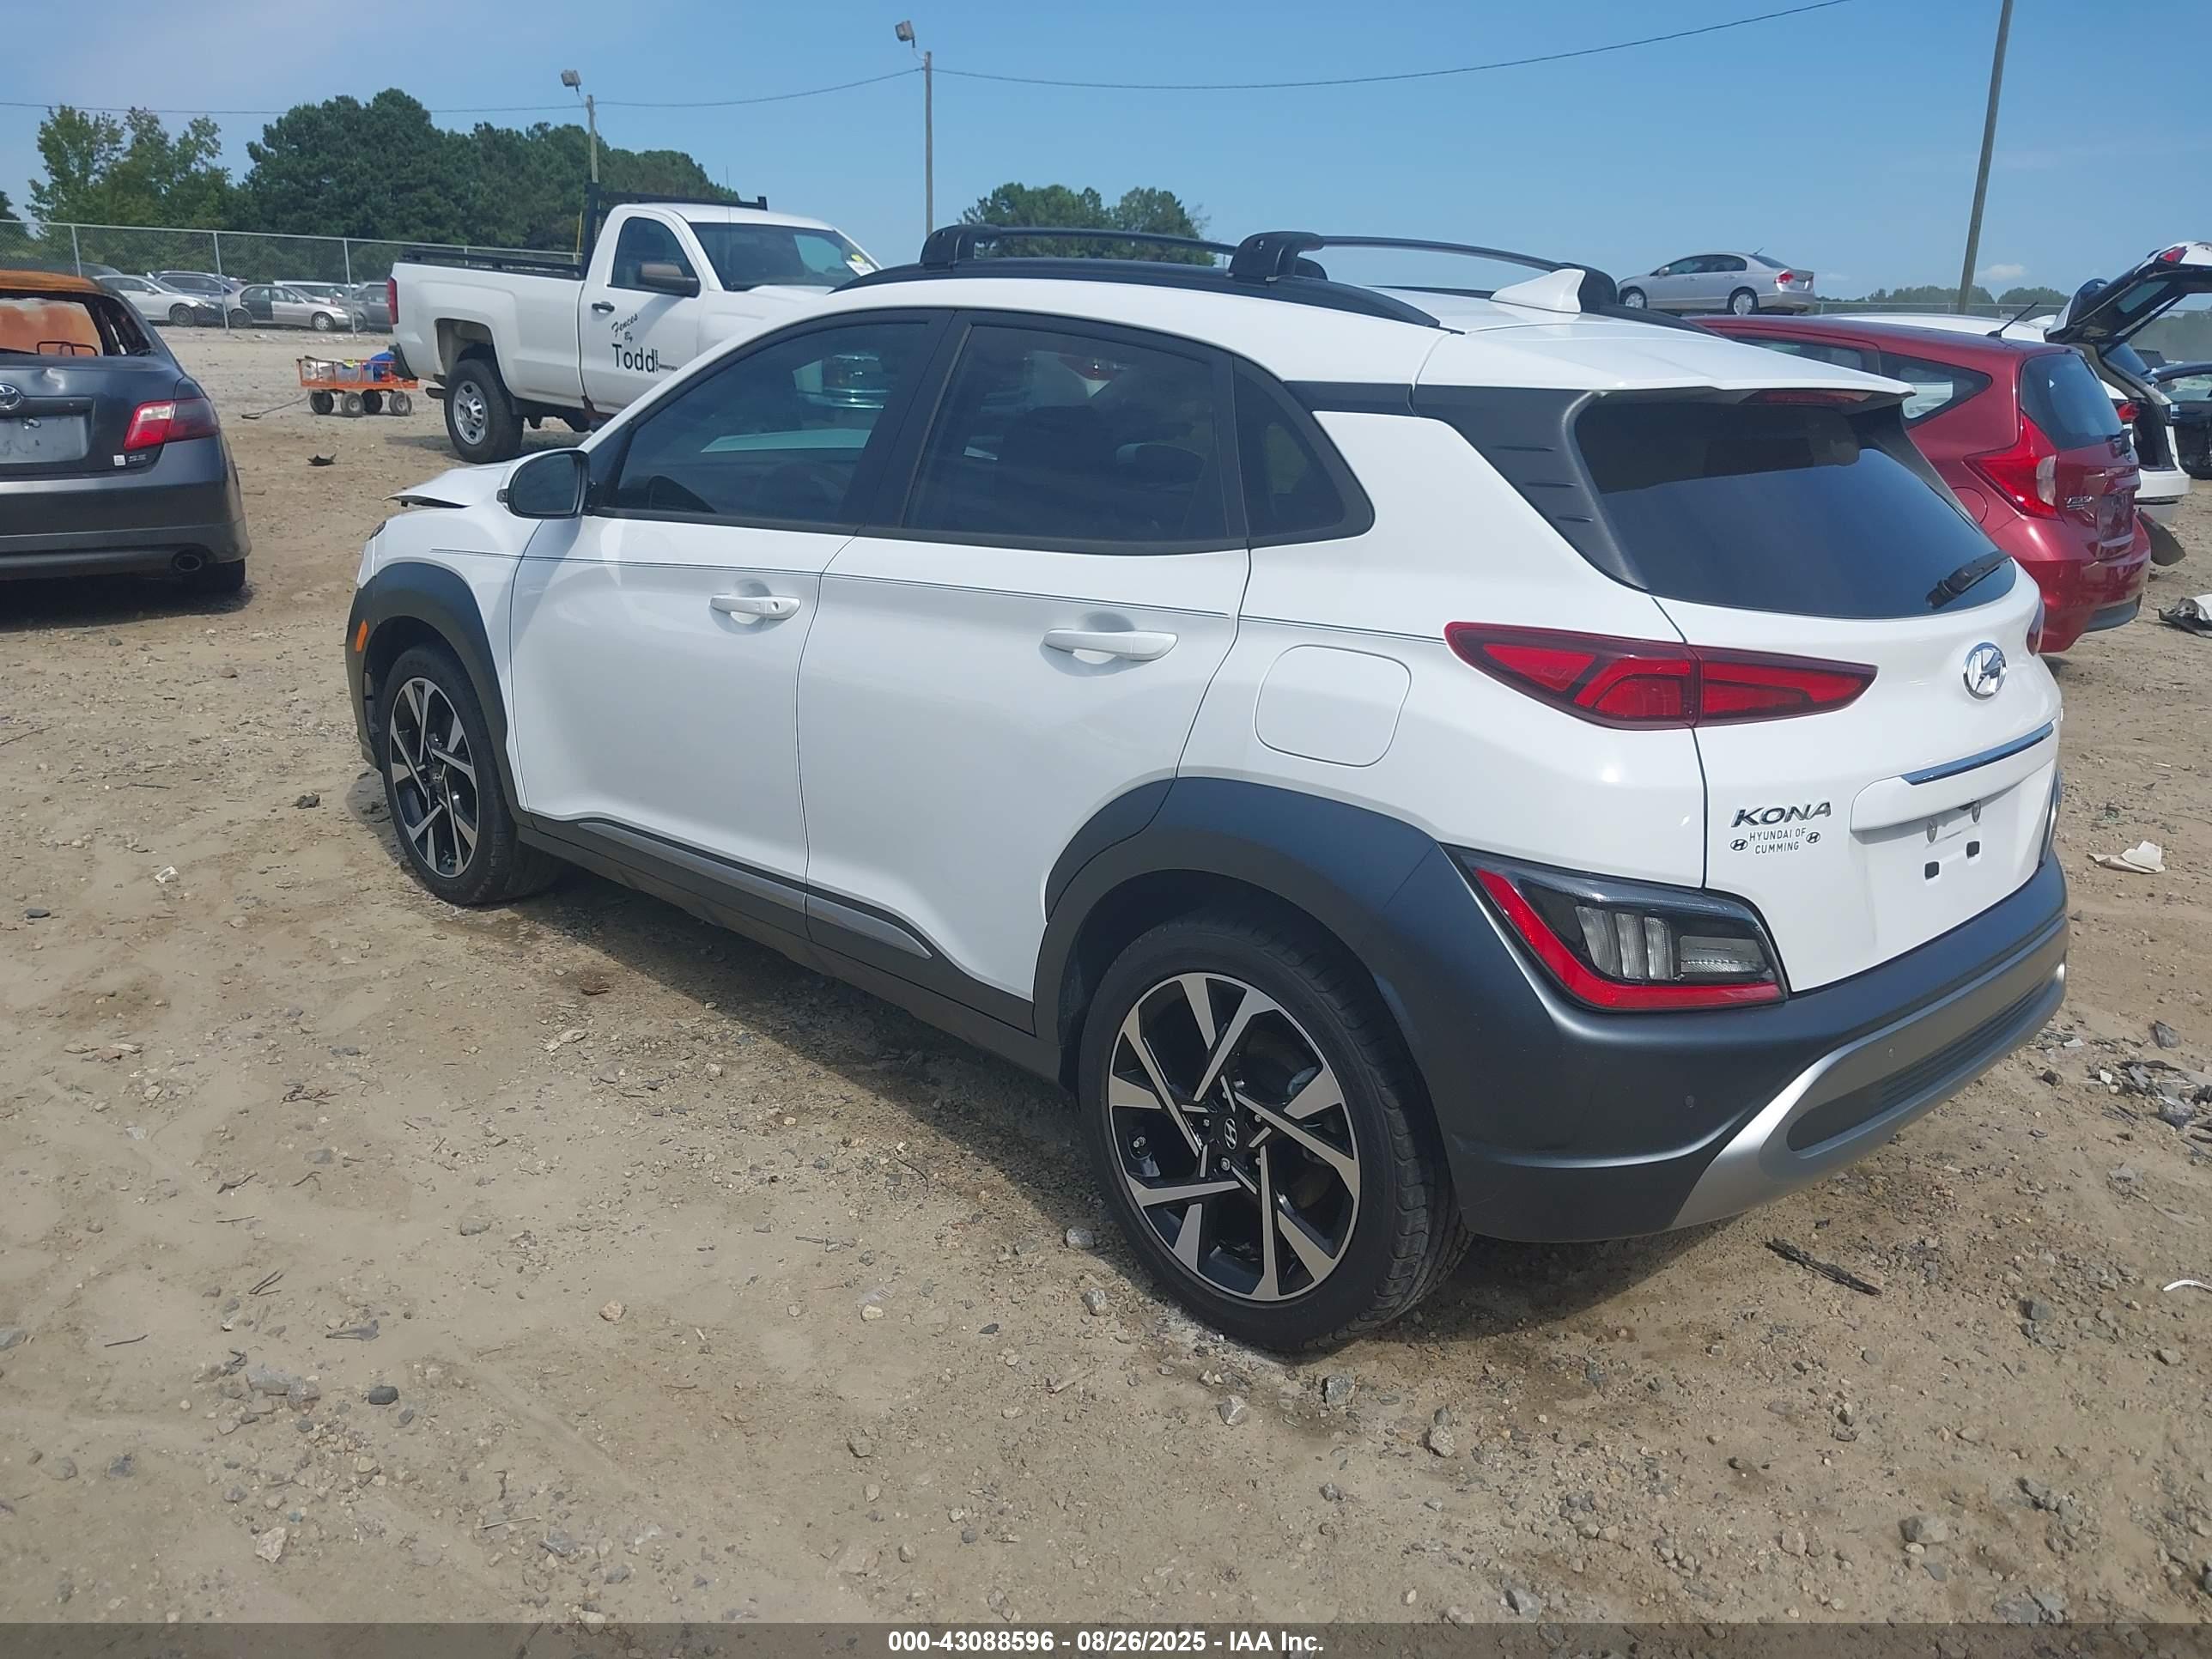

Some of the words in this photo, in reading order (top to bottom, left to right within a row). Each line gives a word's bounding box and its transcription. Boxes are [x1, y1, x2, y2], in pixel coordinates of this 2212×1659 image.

[1730, 801, 1832, 828] KONA
[1749, 830, 1792, 841] HYUNDAI
[1796, 827, 1807, 838] OF
[1755, 841, 1800, 854] CUMMING
